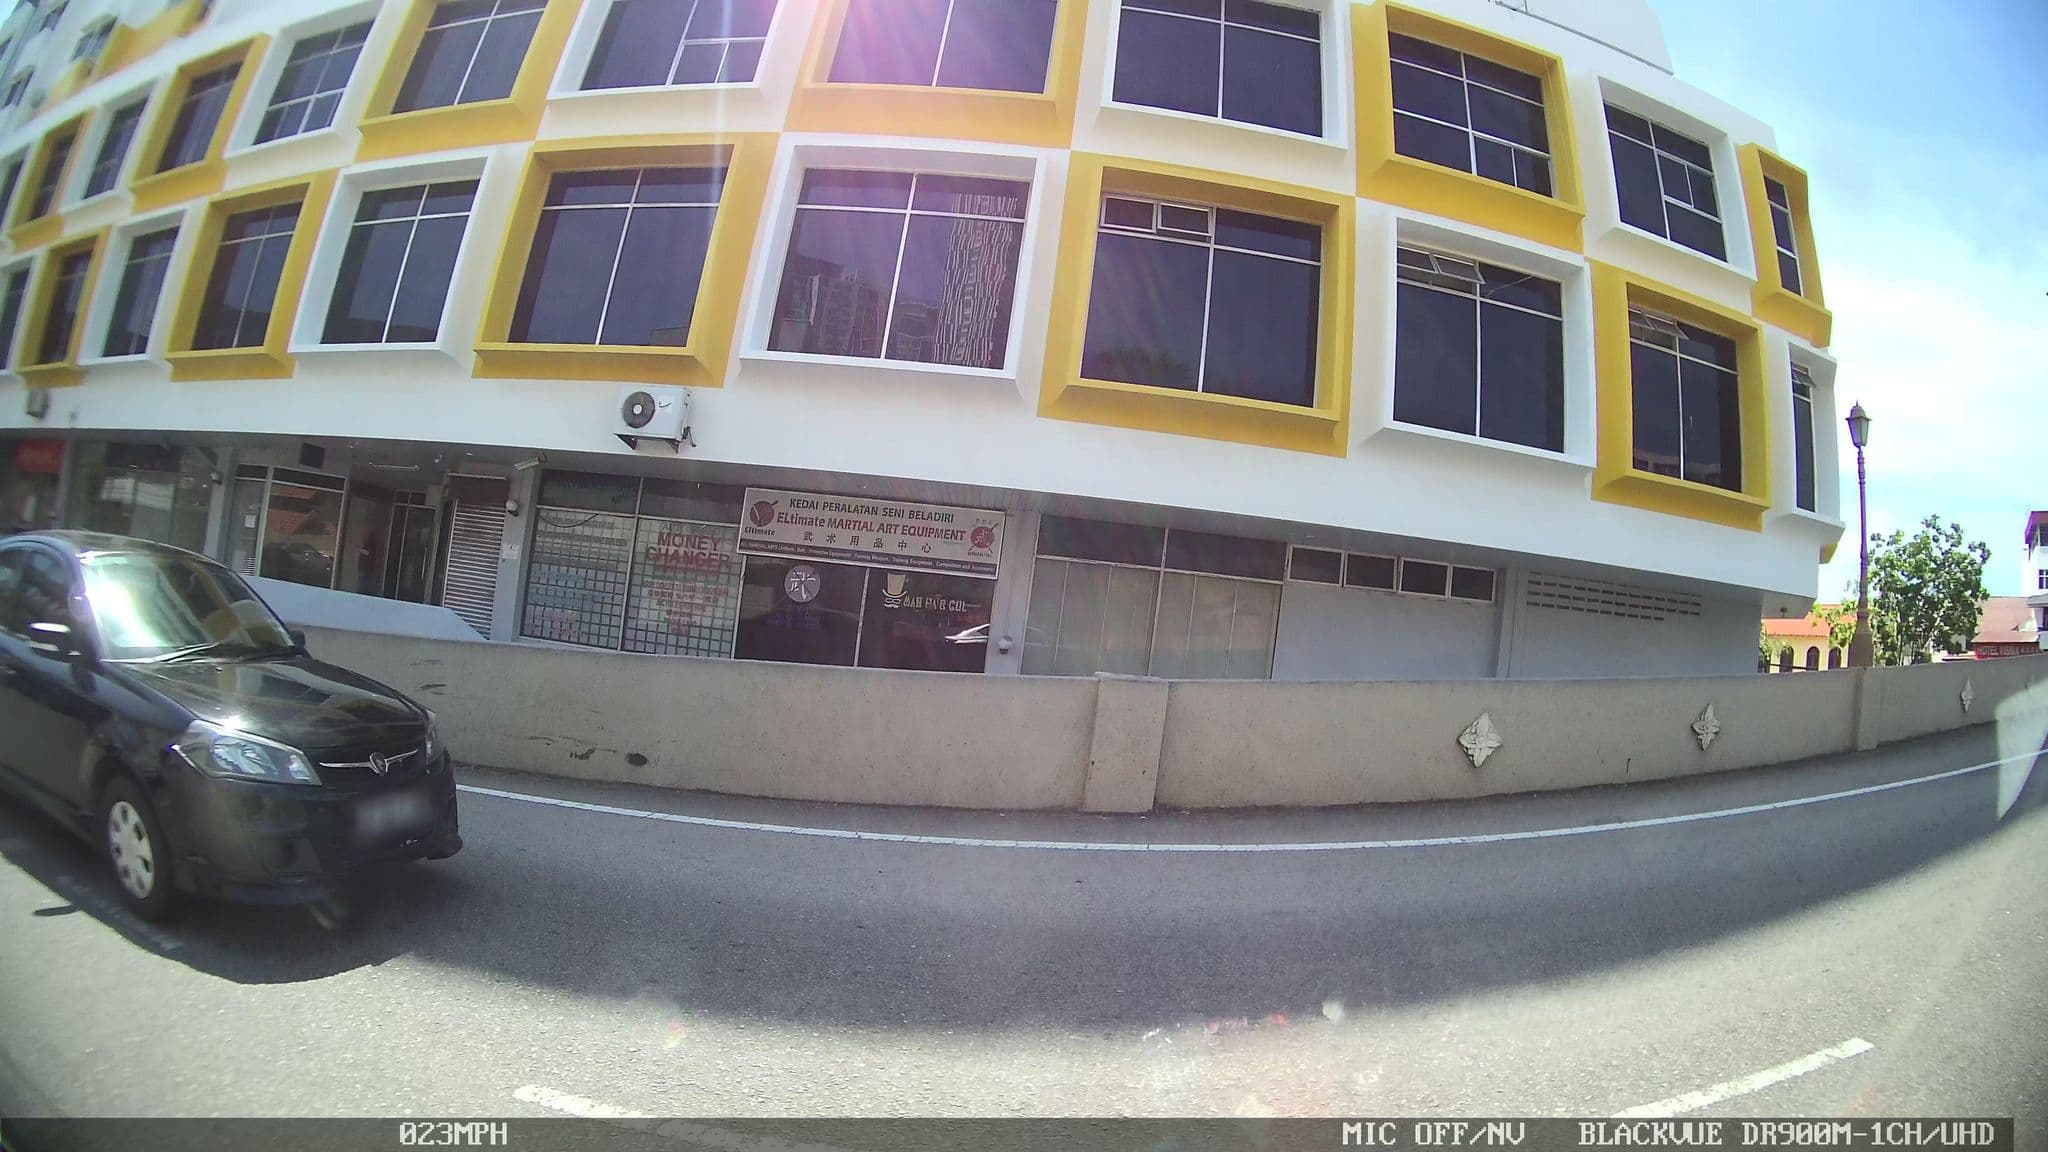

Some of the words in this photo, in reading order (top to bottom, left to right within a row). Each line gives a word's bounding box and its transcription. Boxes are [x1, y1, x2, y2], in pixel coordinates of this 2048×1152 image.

[789, 498, 819, 511] KEDAI
[822, 501, 878, 516] PERALATAN
[882, 507, 905, 518] SENI
[908, 510, 954, 523] BELADIRI
[827, 518, 874, 532] MARTIAL
[876, 523, 900, 535] ART
[901, 525, 966, 541] EQUIPMENT
[657, 533, 720, 551] MONEY
[648, 546, 732, 569] CHANGER
